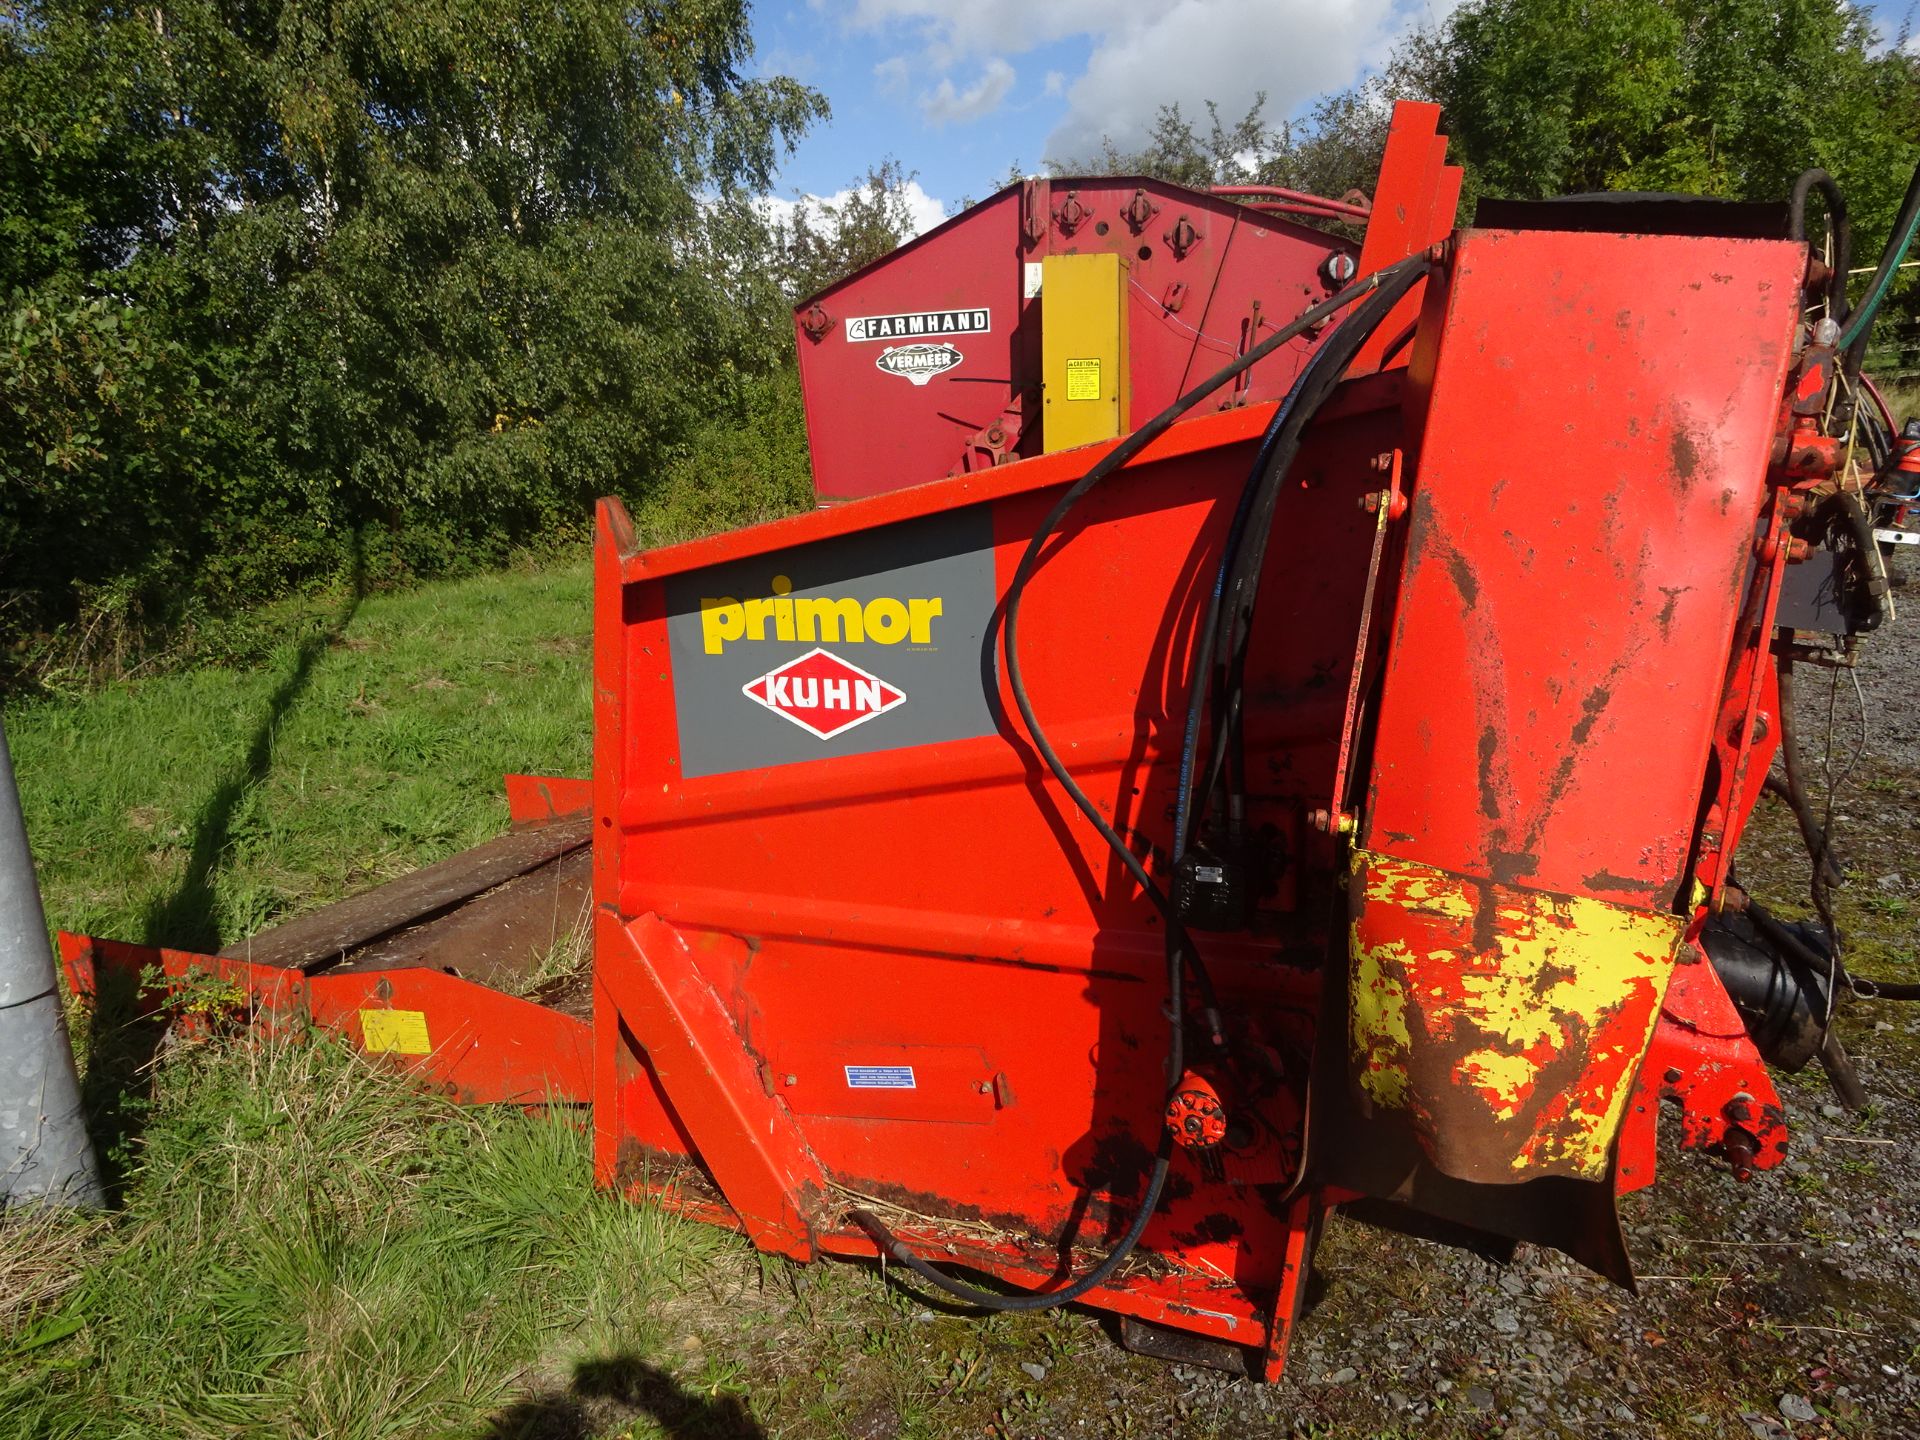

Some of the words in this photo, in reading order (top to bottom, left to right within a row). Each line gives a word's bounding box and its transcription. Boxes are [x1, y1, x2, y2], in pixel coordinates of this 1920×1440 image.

[868, 312, 986, 337] FARMHAND
[886, 353, 951, 369] VERMEER
[701, 575, 942, 654] primor
[766, 675, 881, 711] KUHN
